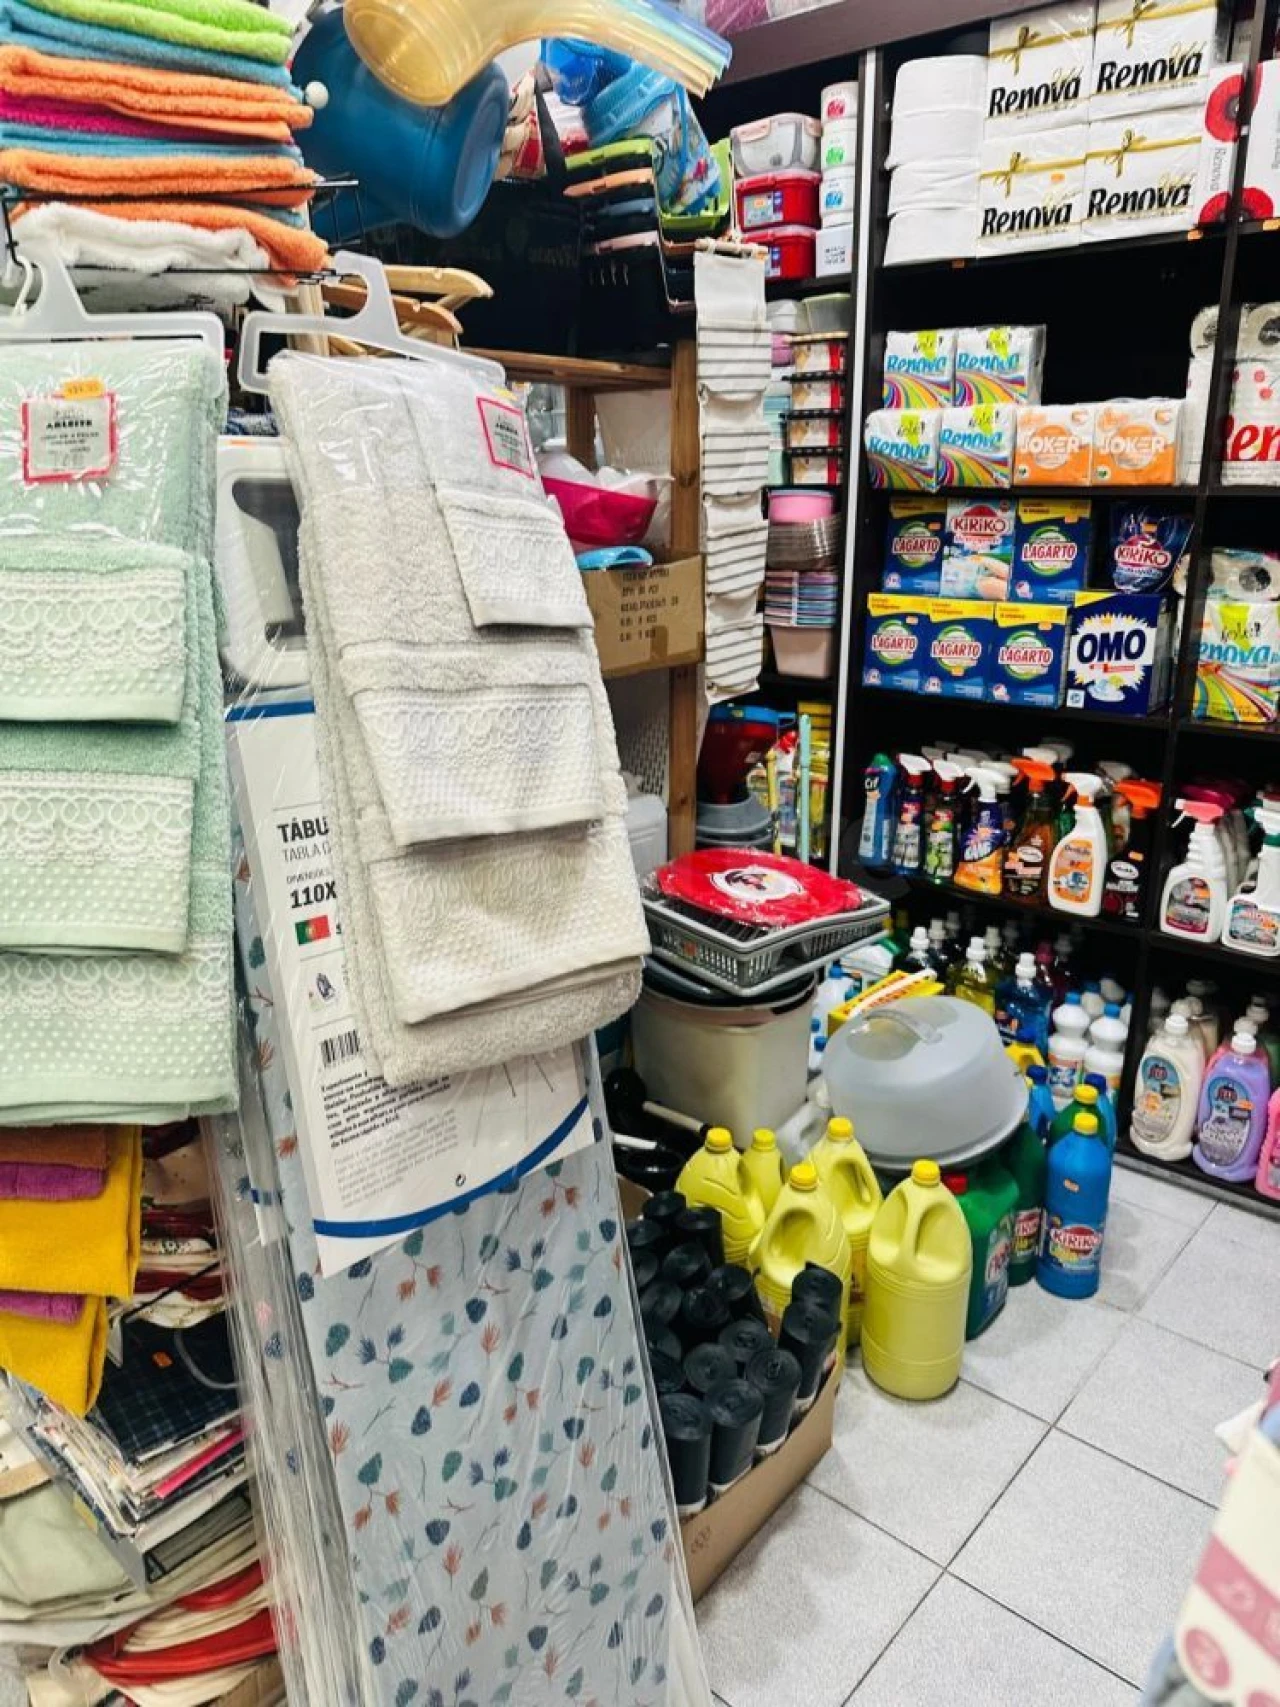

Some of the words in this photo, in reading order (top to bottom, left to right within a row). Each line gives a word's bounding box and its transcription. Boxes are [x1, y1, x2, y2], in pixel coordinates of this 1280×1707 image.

[1096, 52, 1203, 93] Renova
[988, 75, 1081, 118] Renova
[1086, 184, 1192, 218] Renova
[980, 202, 1073, 237] Renova
[887, 355, 948, 373] Renova
[958, 353, 1020, 372] Renova
[941, 428, 1003, 449] Renova
[1021, 436, 1081, 455] JOKER
[1100, 436, 1166, 455] JOKER
[1224, 414, 1280, 462] en
[1076, 628, 1147, 664] OMO
[1200, 642, 1271, 665] enova
[290, 880, 338, 909] 110X
